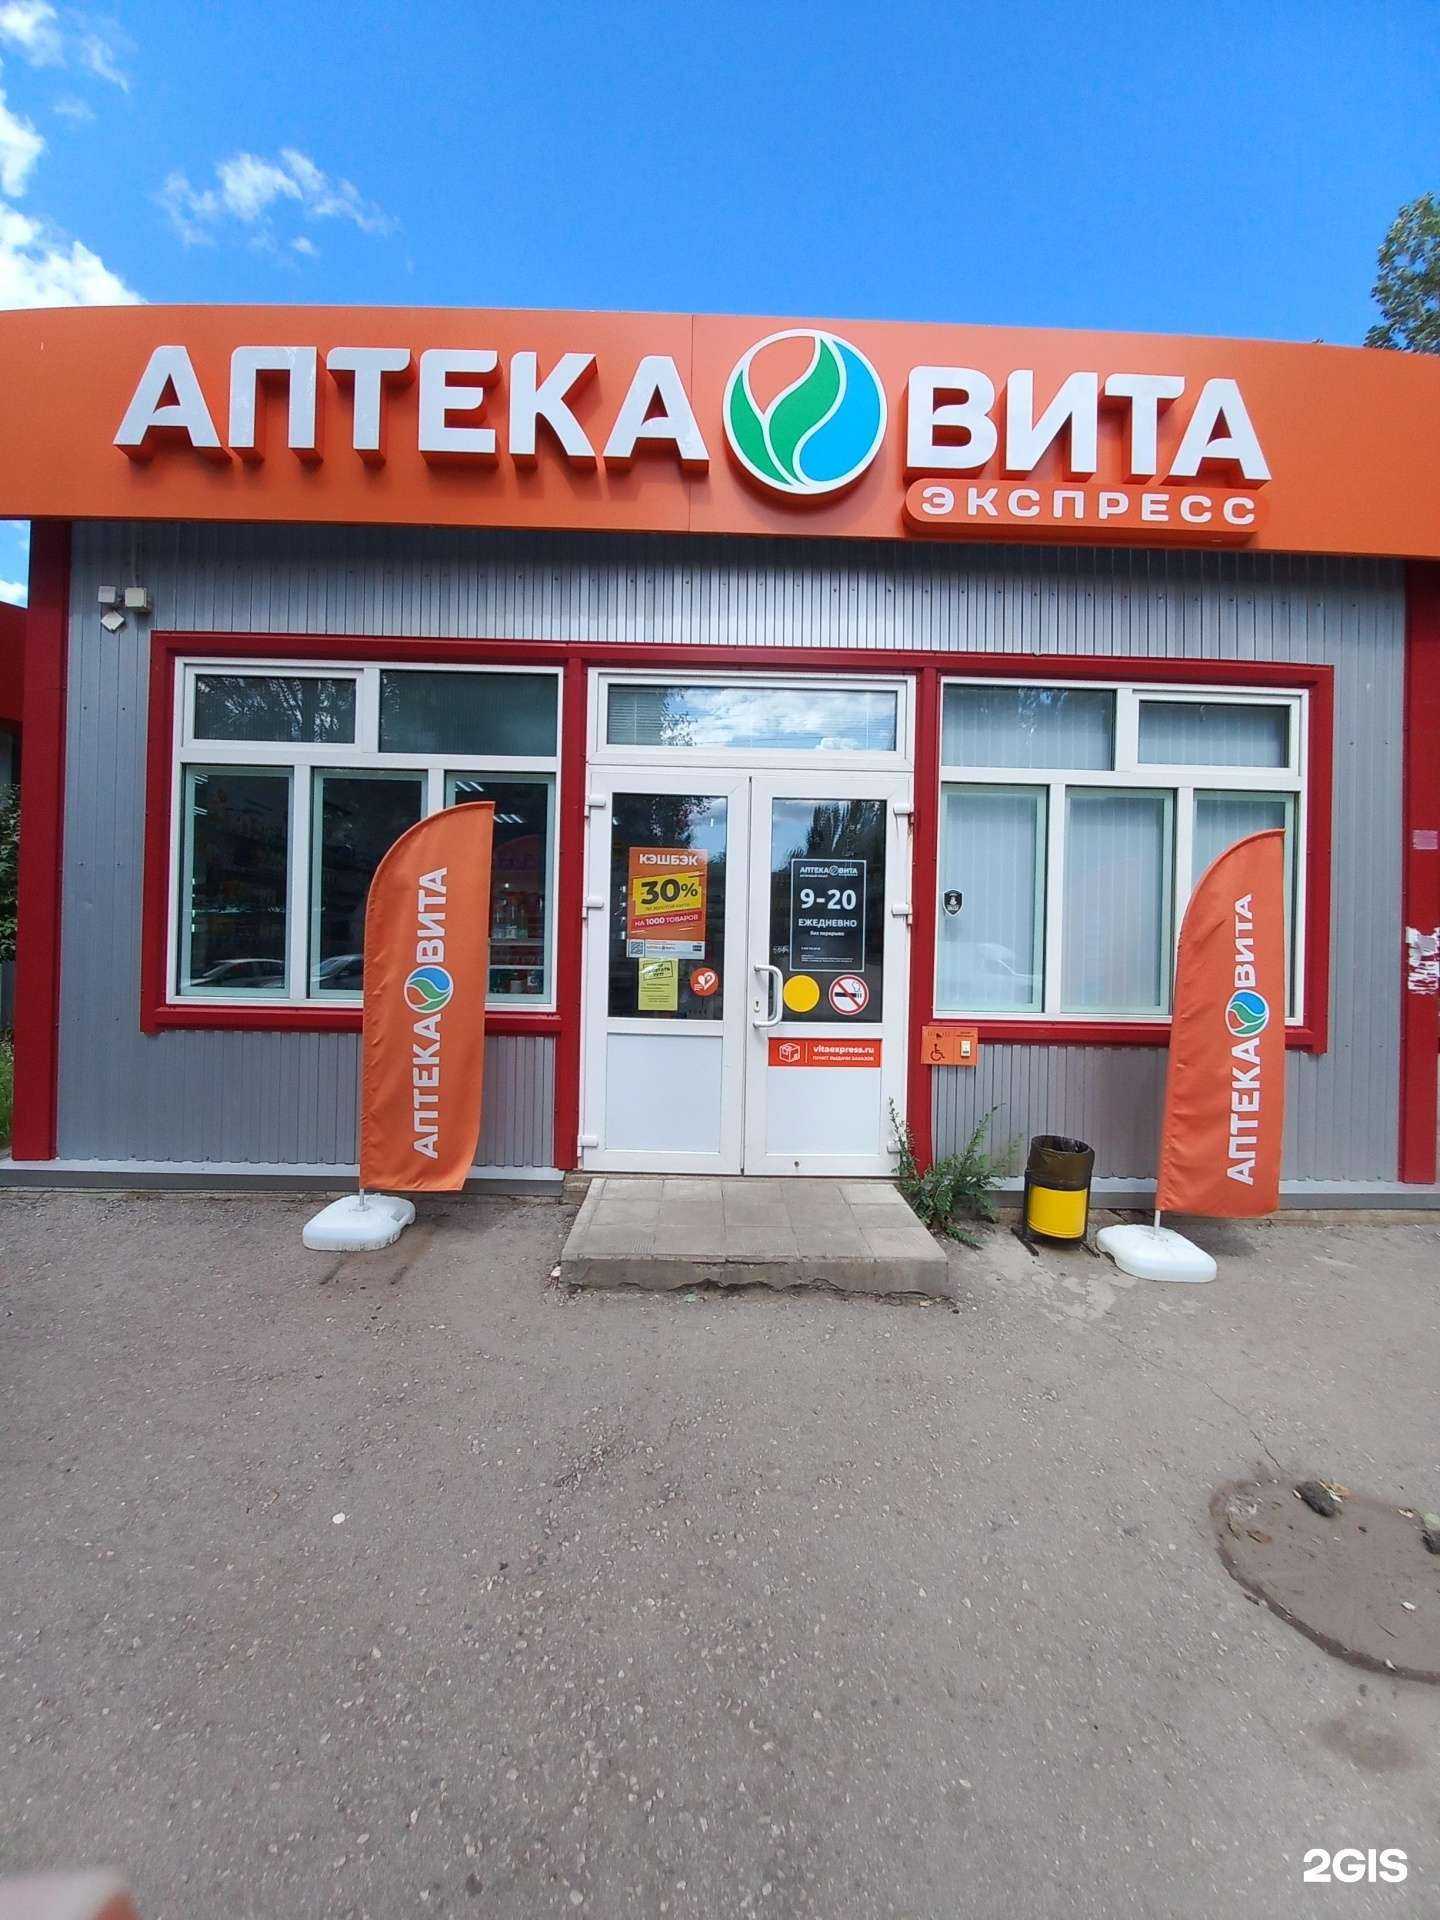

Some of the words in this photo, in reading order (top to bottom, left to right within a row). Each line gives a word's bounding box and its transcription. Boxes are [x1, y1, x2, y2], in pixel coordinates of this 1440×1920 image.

[113, 345, 711, 462] АПТЕКА
[906, 365, 1271, 481] ВИТА
[921, 486, 1256, 525] ЭКСПРЕСС
[639, 853, 698, 866] КЭШБЭК
[800, 866, 828, 874] АПТЕКА
[640, 878, 698, 905] 30%
[800, 888, 857, 911] 9-20
[416, 866, 448, 964] ВИТА
[646, 918, 665, 926] 1000
[666, 914, 699, 924] ТОВАРОВ
[798, 918, 858, 929] ЕЖЕДНЕВНО
[1235, 894, 1256, 988] ВИТА
[813, 1045, 875, 1055] vitaexpress.ru
[413, 1014, 442, 1160] АПТЕКА
[1227, 1037, 1261, 1186] АПТЕКА
